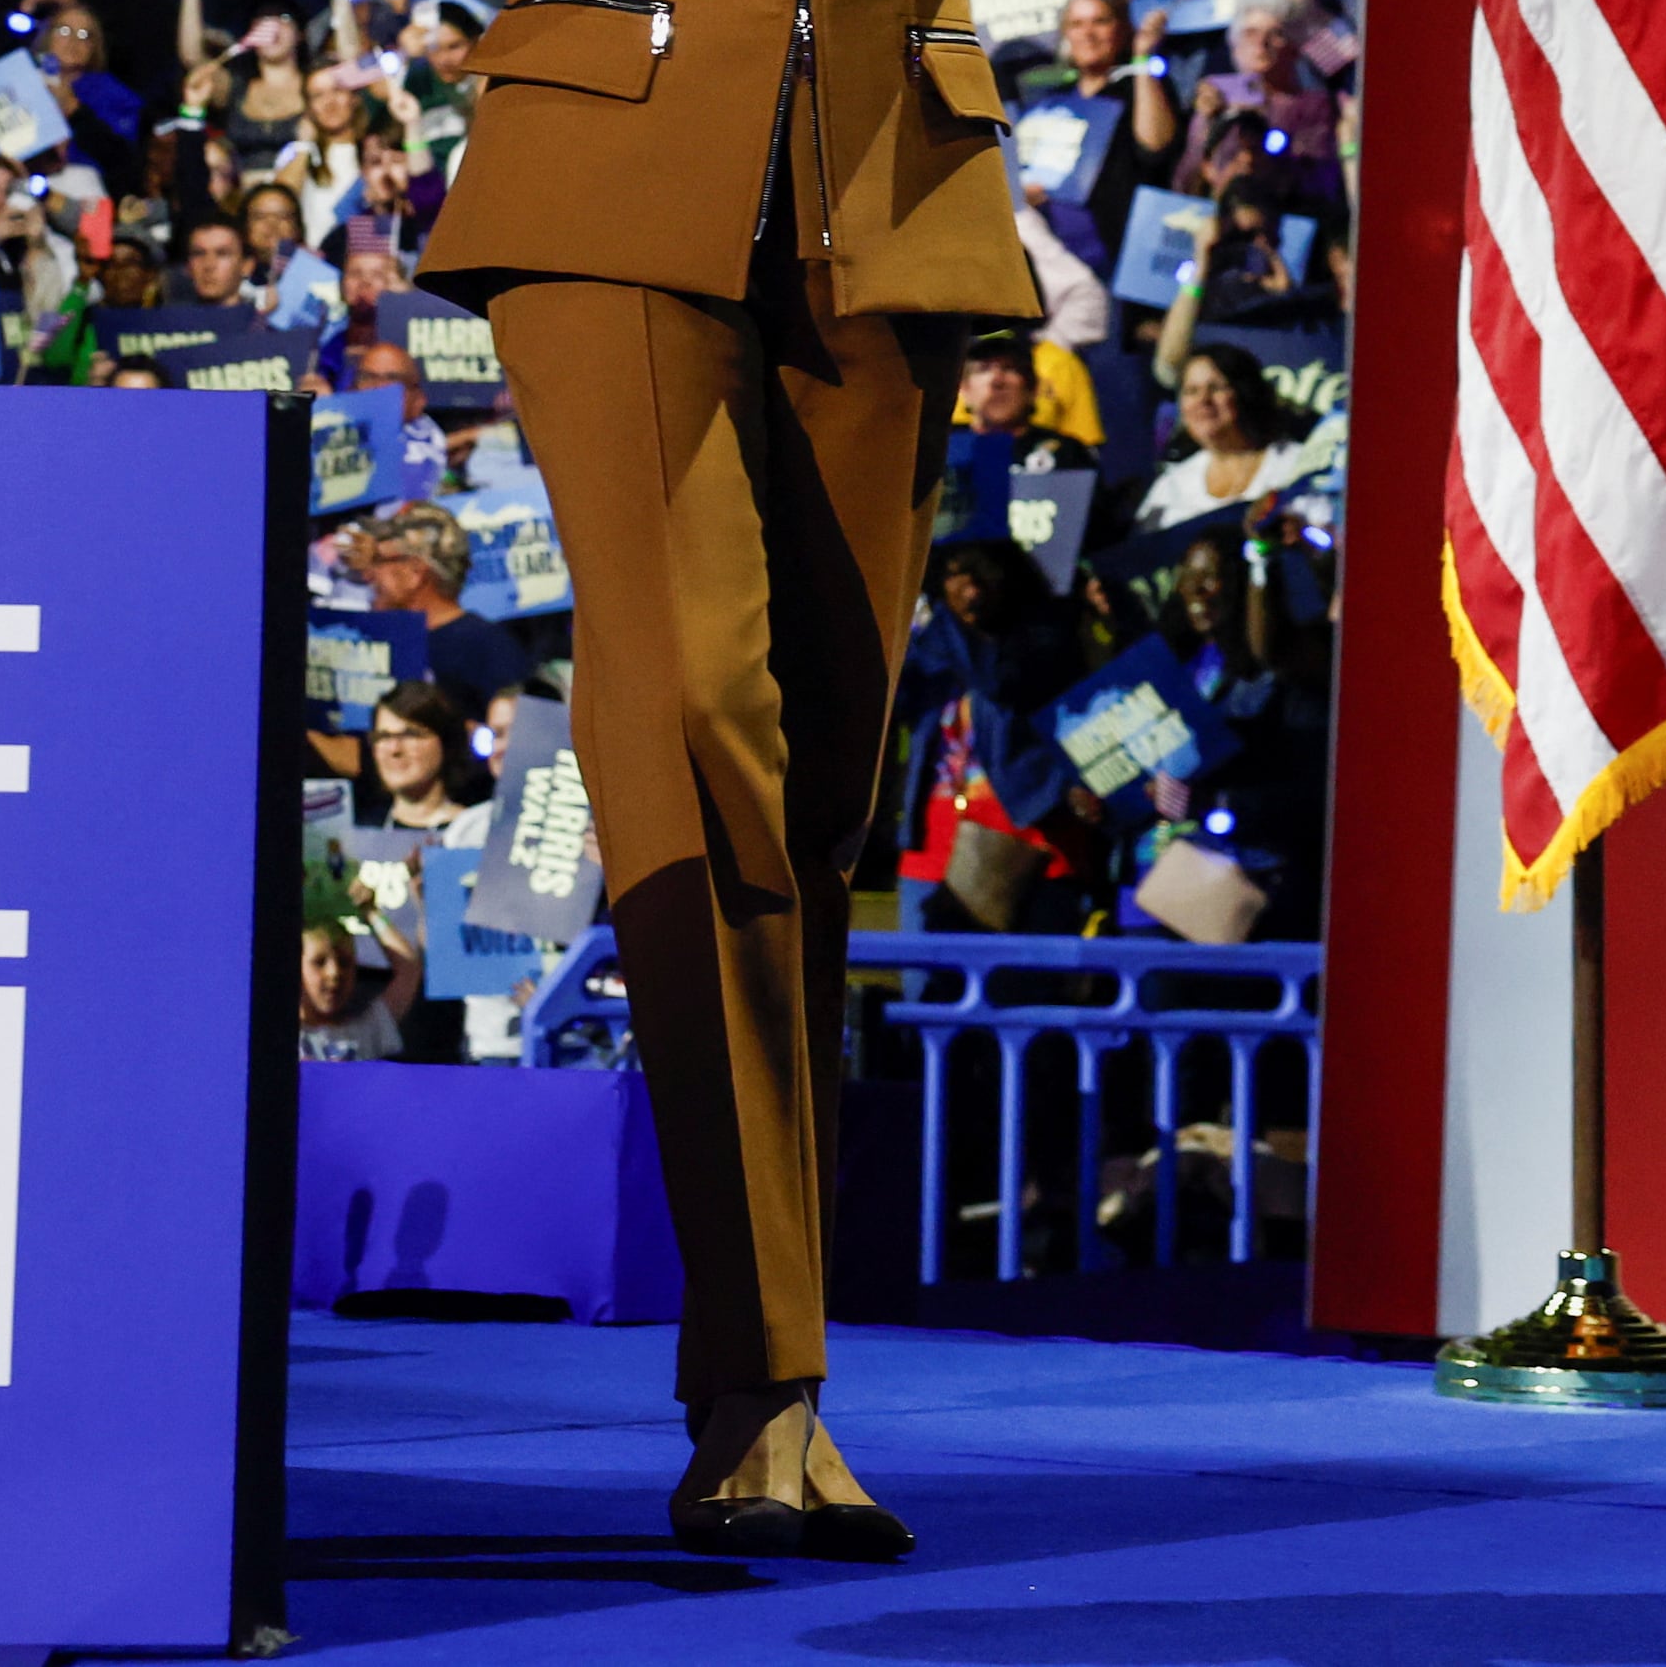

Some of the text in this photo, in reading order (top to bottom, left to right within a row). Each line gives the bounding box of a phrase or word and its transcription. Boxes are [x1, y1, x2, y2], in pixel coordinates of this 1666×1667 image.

[407, 317, 496, 358] HARRI
[423, 355, 502, 382] WALZ
[509, 767, 552, 870] WALZ
